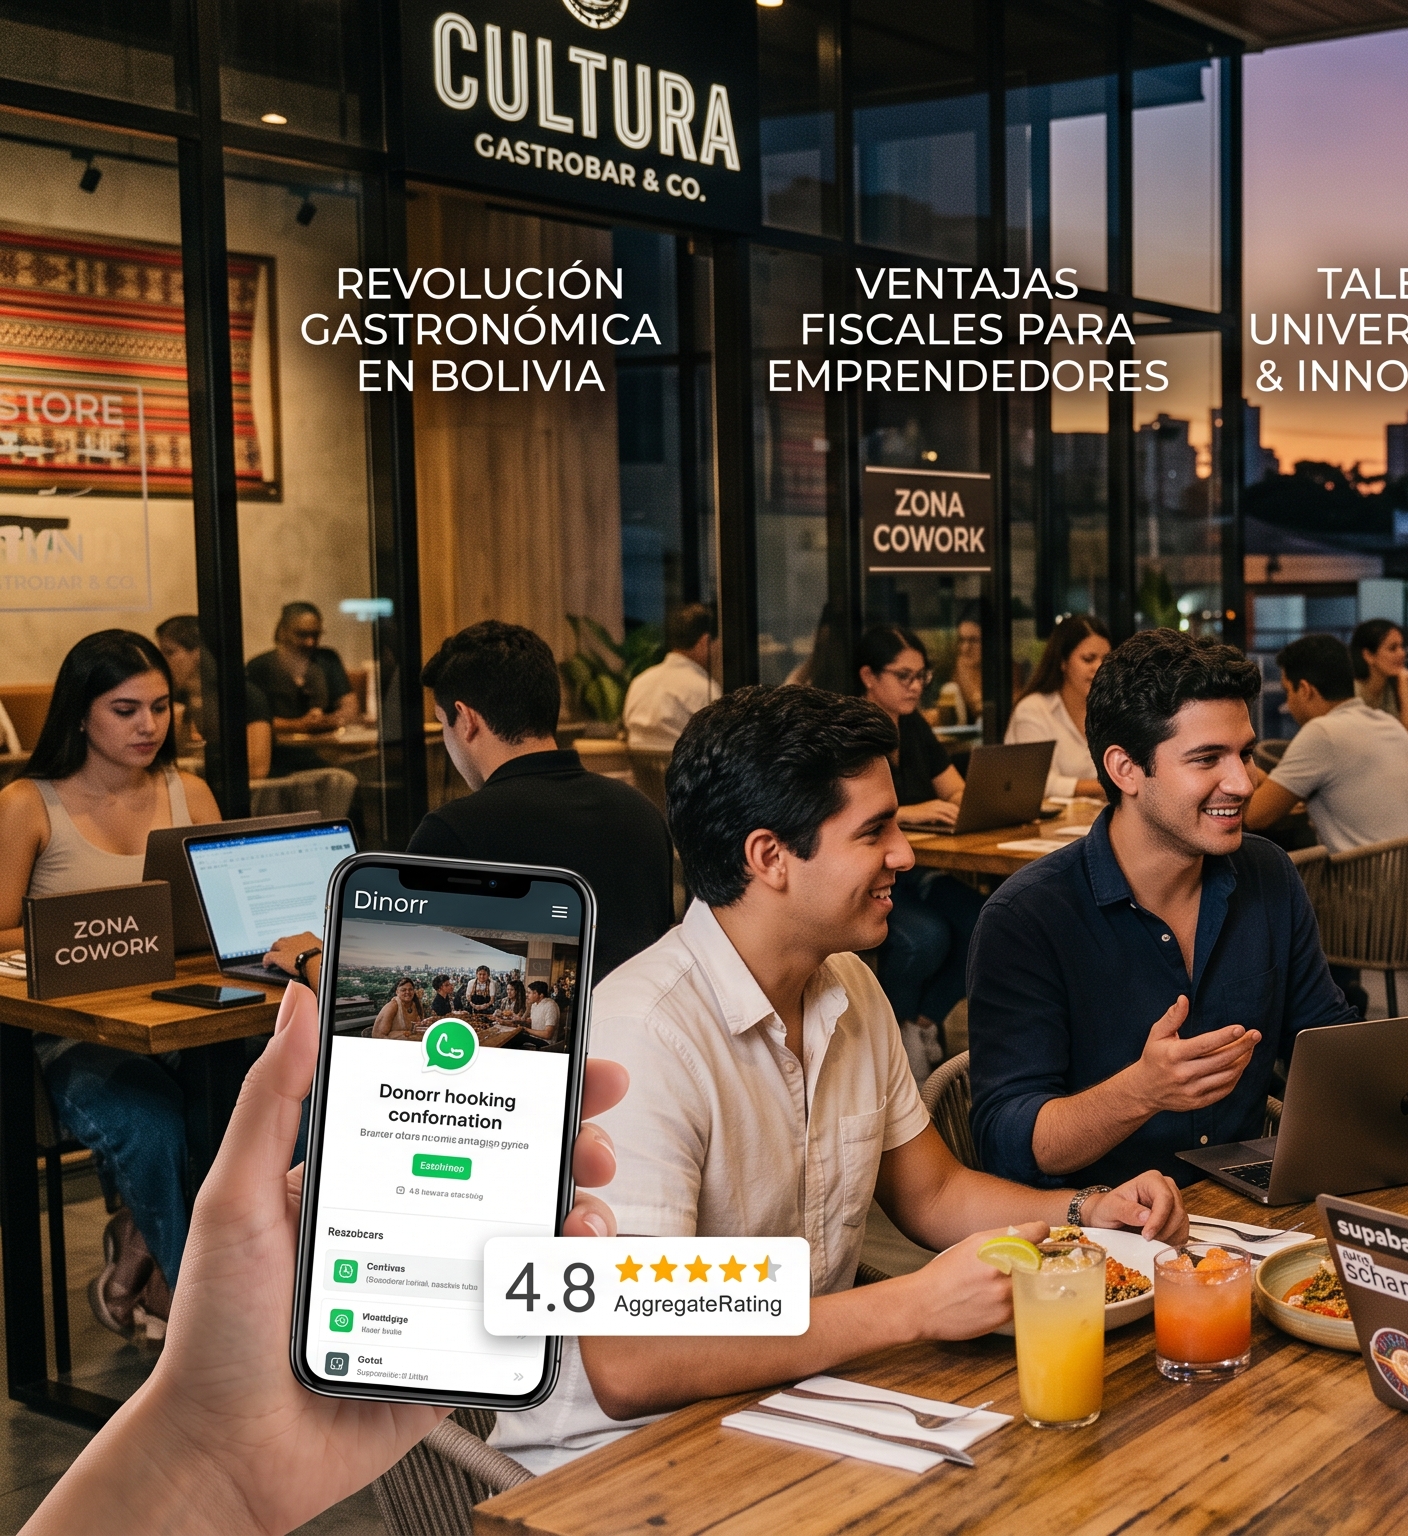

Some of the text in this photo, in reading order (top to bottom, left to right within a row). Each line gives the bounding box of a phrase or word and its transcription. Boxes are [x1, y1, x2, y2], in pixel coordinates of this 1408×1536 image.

[433, 11, 741, 172] CULTURA
[475, 132, 707, 203] GASTROBAR & CO.
[894, 488, 966, 518] ZONA
[872, 524, 987, 554] COWORK
[0, 574, 83, 591] TROBAR
[354, 890, 428, 914] Dinorr
[73, 915, 140, 939] ZONA
[54, 935, 160, 966] COWORK
[379, 1083, 516, 1112] Donorr hooking
[388, 1107, 502, 1131] confornation
